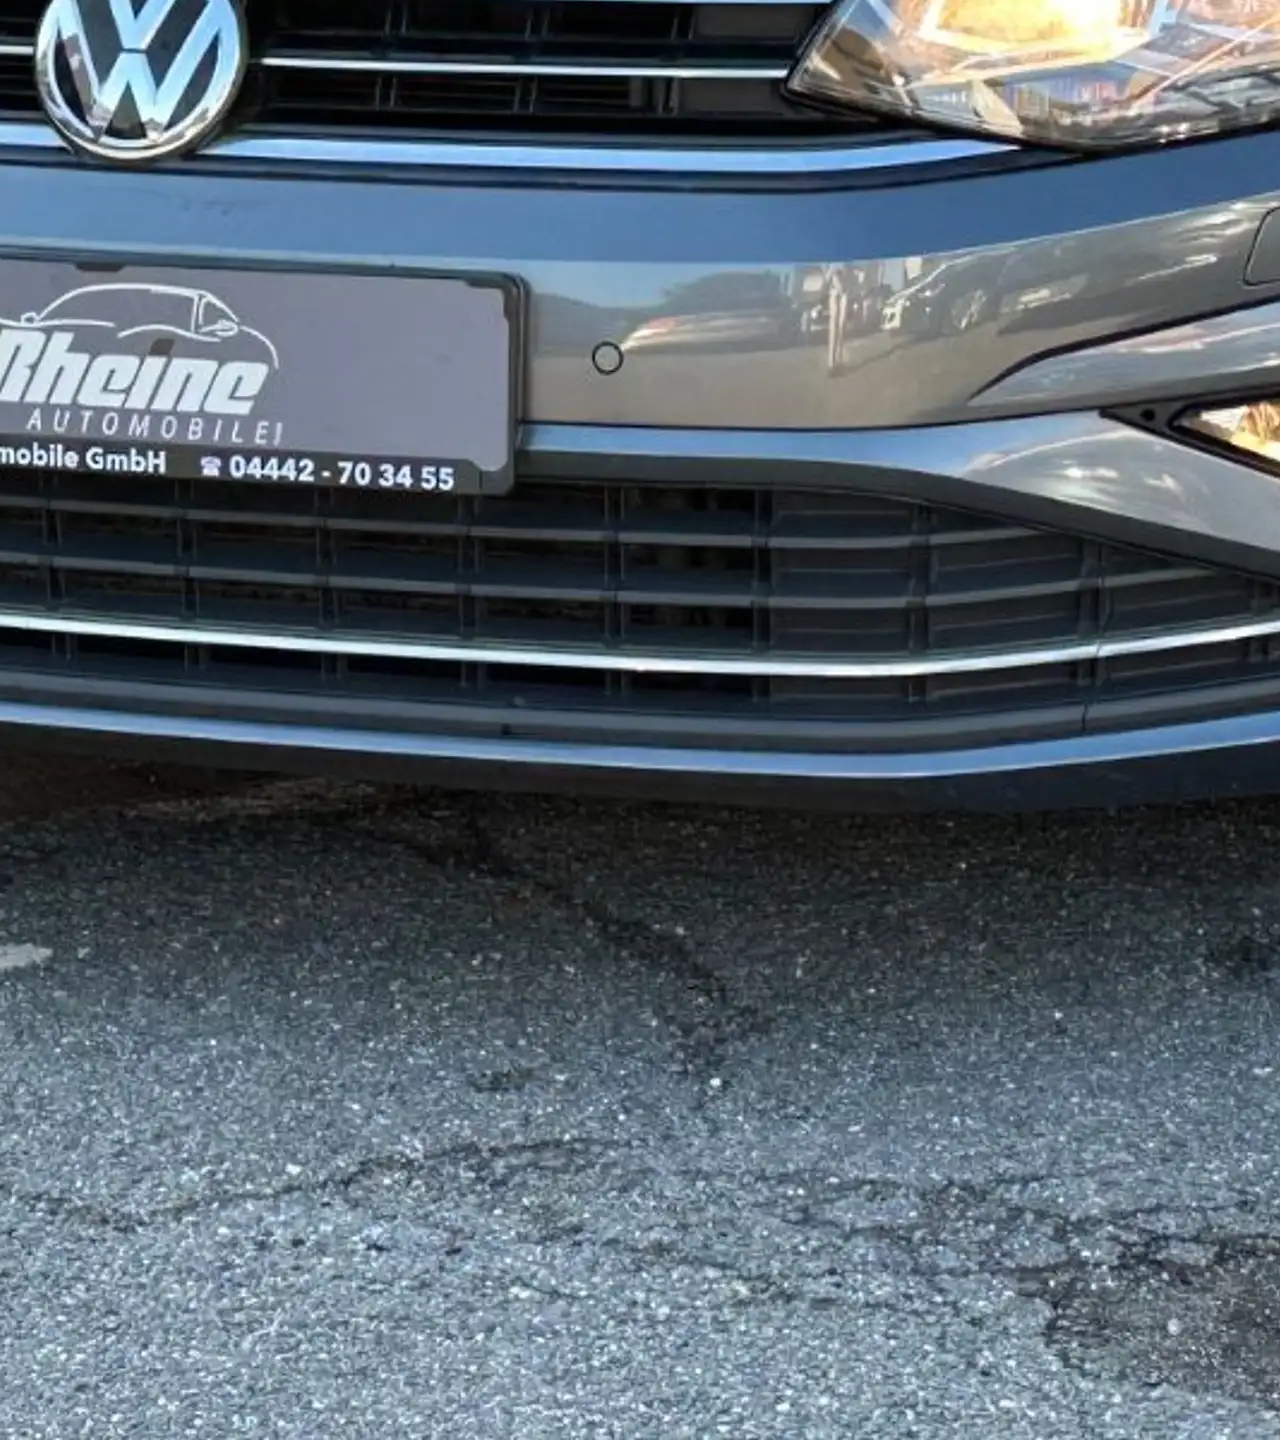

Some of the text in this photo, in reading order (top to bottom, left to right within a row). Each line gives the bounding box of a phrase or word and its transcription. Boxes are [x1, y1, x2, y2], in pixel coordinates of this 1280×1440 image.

[85, 446, 167, 474] GmbH
[228, 456, 315, 483] 04442
[337, 462, 371, 487] 70
[377, 464, 413, 489] 34
[420, 466, 455, 491] 55
